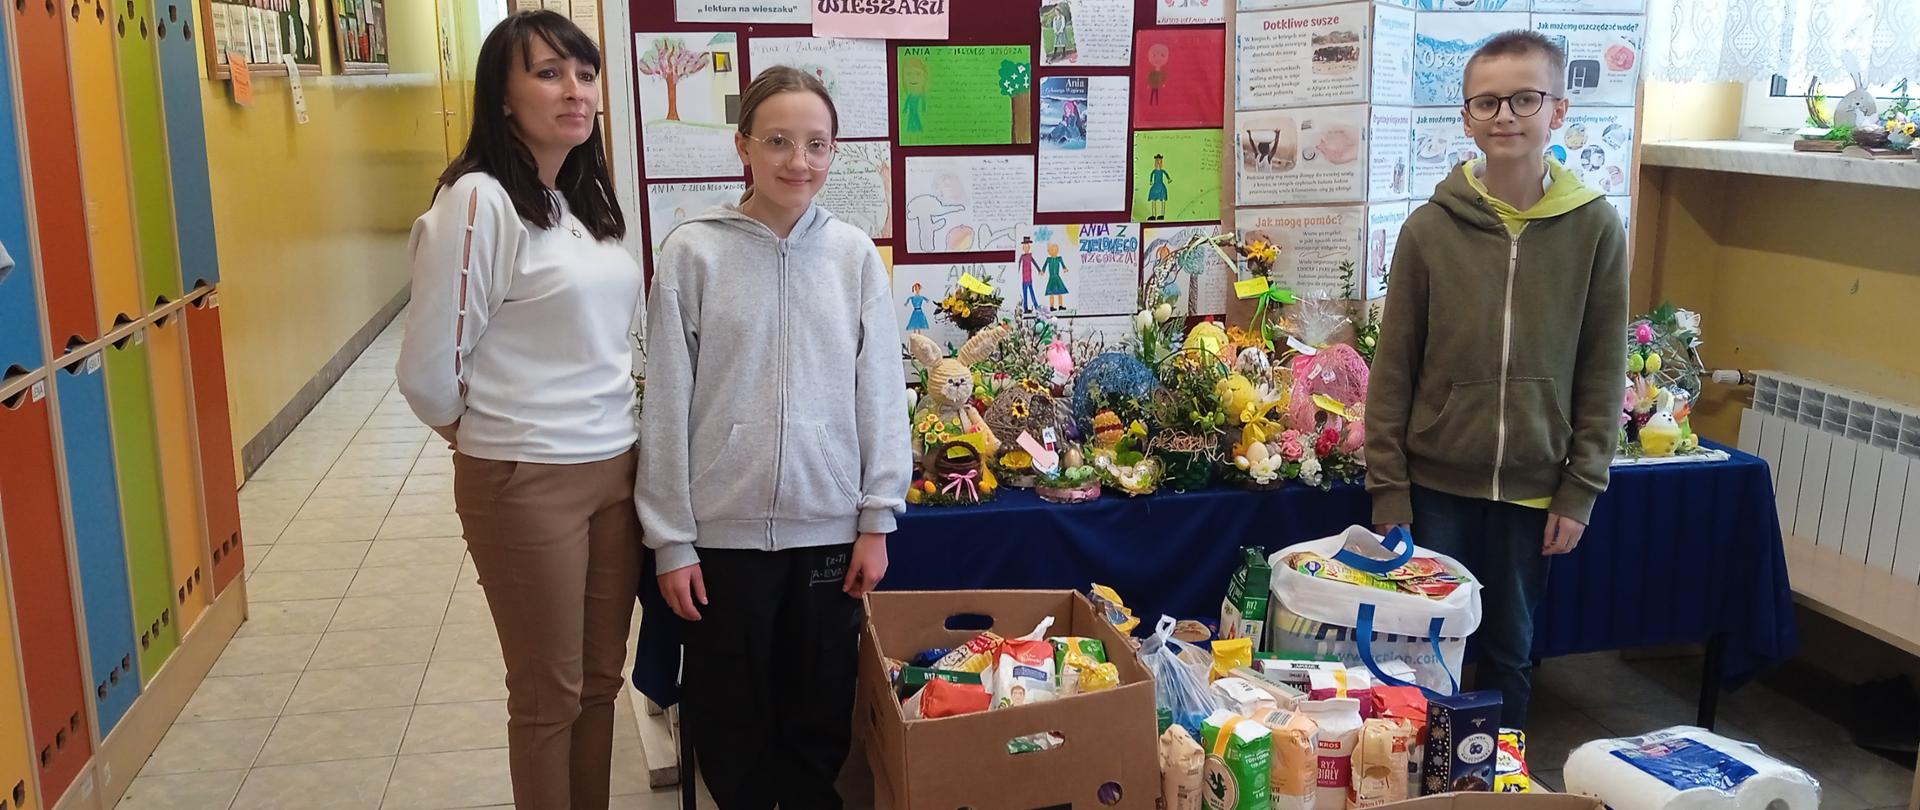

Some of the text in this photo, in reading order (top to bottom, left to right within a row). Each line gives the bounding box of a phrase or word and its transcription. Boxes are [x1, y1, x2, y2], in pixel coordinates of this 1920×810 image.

[817, 0, 945, 15] WIESZAKU
[1263, 16, 1339, 30] Dotkliwe susze
[1550, 22, 1577, 31] możemy
[1578, 23, 1616, 31] oszczędzać
[1617, 24, 1638, 32] wodę?
[904, 48, 930, 56] ANIA
[1066, 79, 1084, 88] Ania
[1417, 116, 1428, 124] Jak
[1432, 116, 1456, 124] możemy
[652, 185, 674, 193] ANIA
[1256, 215, 1343, 228] Jak mogę pomóc?
[1079, 223, 1127, 237] ANIA Z
[1079, 237, 1138, 252] ZIELONEGO
[1321, 760, 1336, 769] RYŻ
[1318, 769, 1339, 780] BIAŁY
